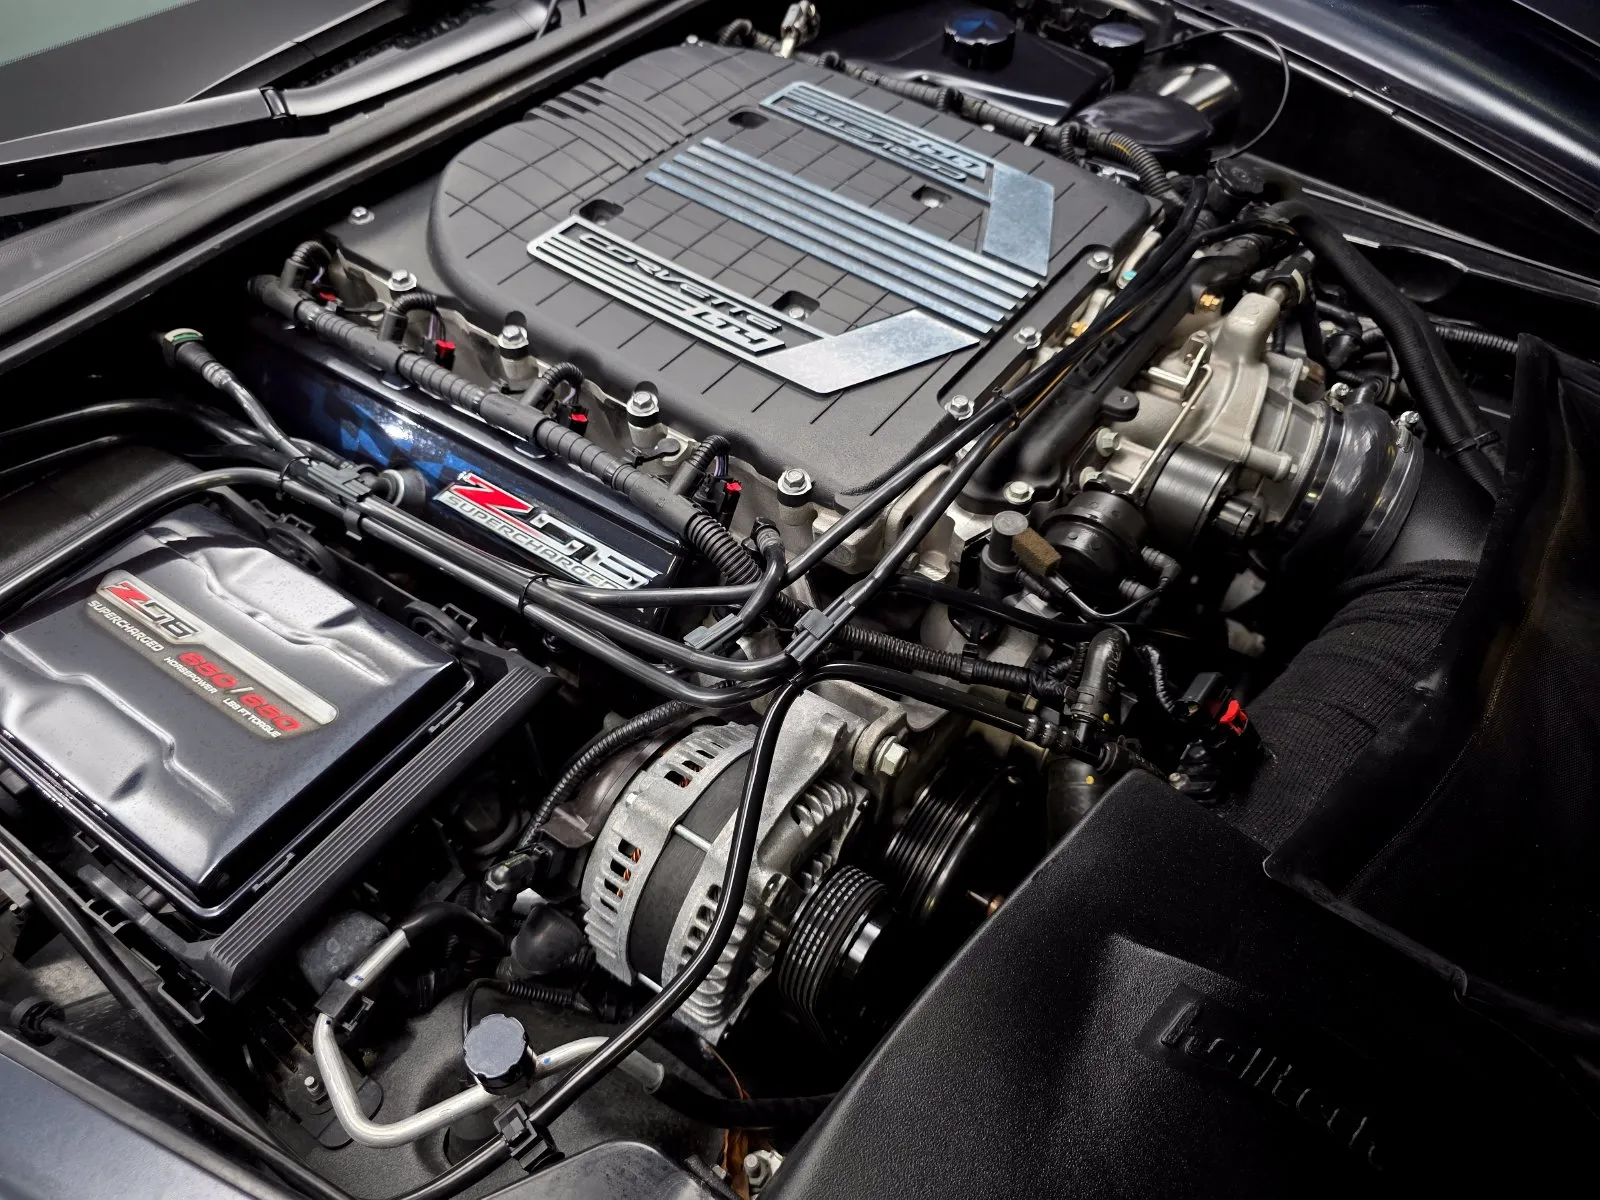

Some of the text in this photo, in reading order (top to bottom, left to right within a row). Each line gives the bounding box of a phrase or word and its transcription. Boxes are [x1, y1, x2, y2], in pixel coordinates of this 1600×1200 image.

[578, 232, 783, 333] CORVETTE
[691, 309, 769, 346] LT4
[450, 471, 663, 590] Z06
[87, 599, 165, 652] SUPERCHARGED
[103, 580, 201, 639] Z06
[163, 656, 218, 694] HORSEPOWER
[247, 714, 282, 738] TORQUE
